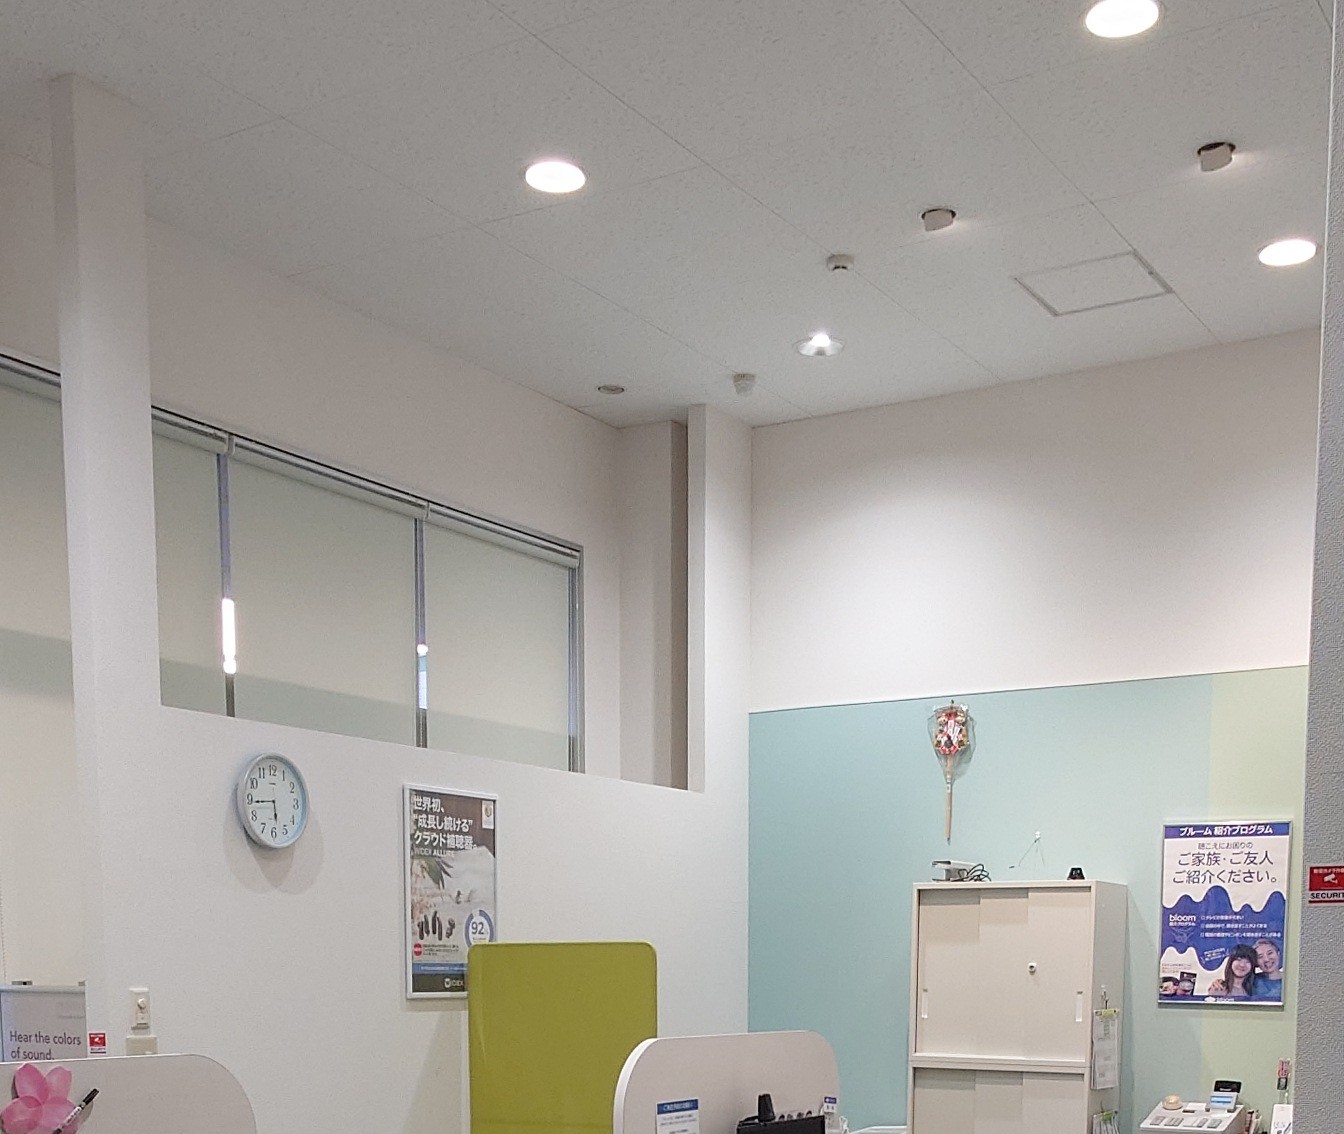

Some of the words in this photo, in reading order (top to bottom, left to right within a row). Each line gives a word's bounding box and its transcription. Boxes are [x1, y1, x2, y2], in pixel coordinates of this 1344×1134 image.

[258, 767, 265, 779] 11
[268, 764, 277, 776] 12
[282, 770, 285, 781] 1
[250, 778, 258, 790] 10
[290, 782, 295, 794] 2
[247, 793, 253, 805] 9
[293, 798, 299, 810] 3
[414, 796, 445, 813] 世界初、
[251, 810, 257, 821] 8
[290, 814, 295, 825] 4
[260, 822, 266, 834] 7
[270, 827, 277, 839] 6
[282, 825, 288, 836] 5
[1180, 826, 1212, 836] ブルーム
[1214, 825, 1273, 836] 紹介プログラム
[1178, 851, 1274, 866] ご家族・ご友人
[1173, 869, 1277, 884] ご紹介ください。
[10, 1031, 32, 1043] Hear
[34, 1032, 50, 1043] the
[53, 1032, 82, 1046] colors
[11, 1047, 20, 1059] of
[23, 1048, 55, 1060] sound.
